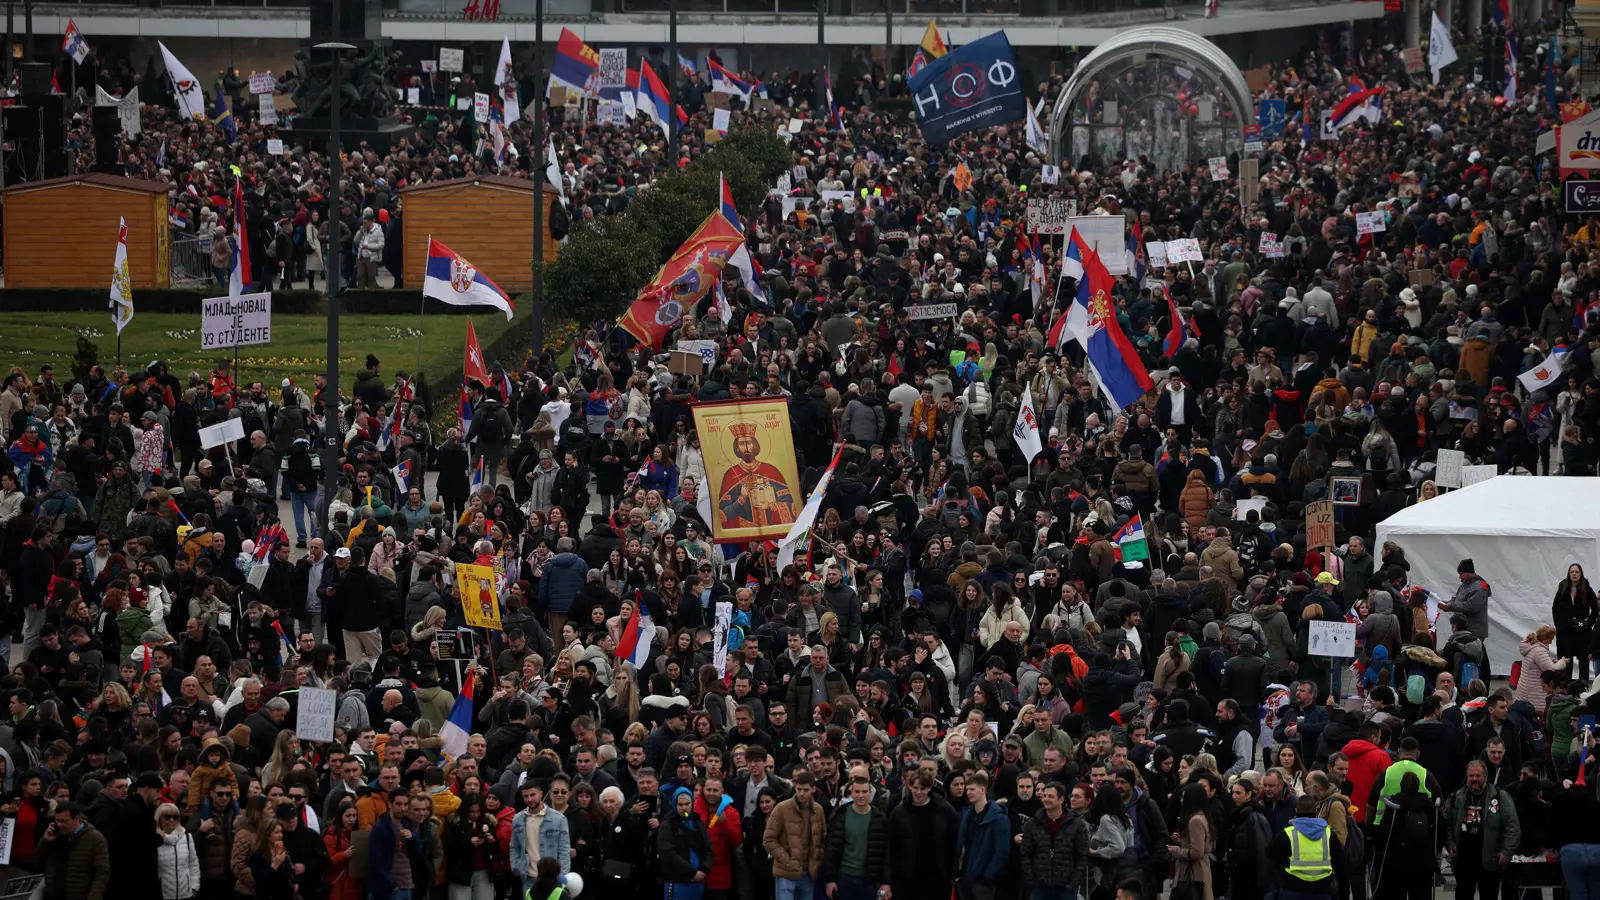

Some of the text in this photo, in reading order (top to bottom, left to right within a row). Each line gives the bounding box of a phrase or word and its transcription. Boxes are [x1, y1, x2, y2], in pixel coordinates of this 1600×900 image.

[205, 299, 267, 316] МЛАДЕНОВАЦ
[231, 315, 243, 329] ЈЕ
[204, 327, 269, 346] УЗ СТУДЕНТЕ
[1318, 514, 1331, 523] UZ
[308, 702, 332, 714] LUDA
[300, 714, 316, 726] SVE
